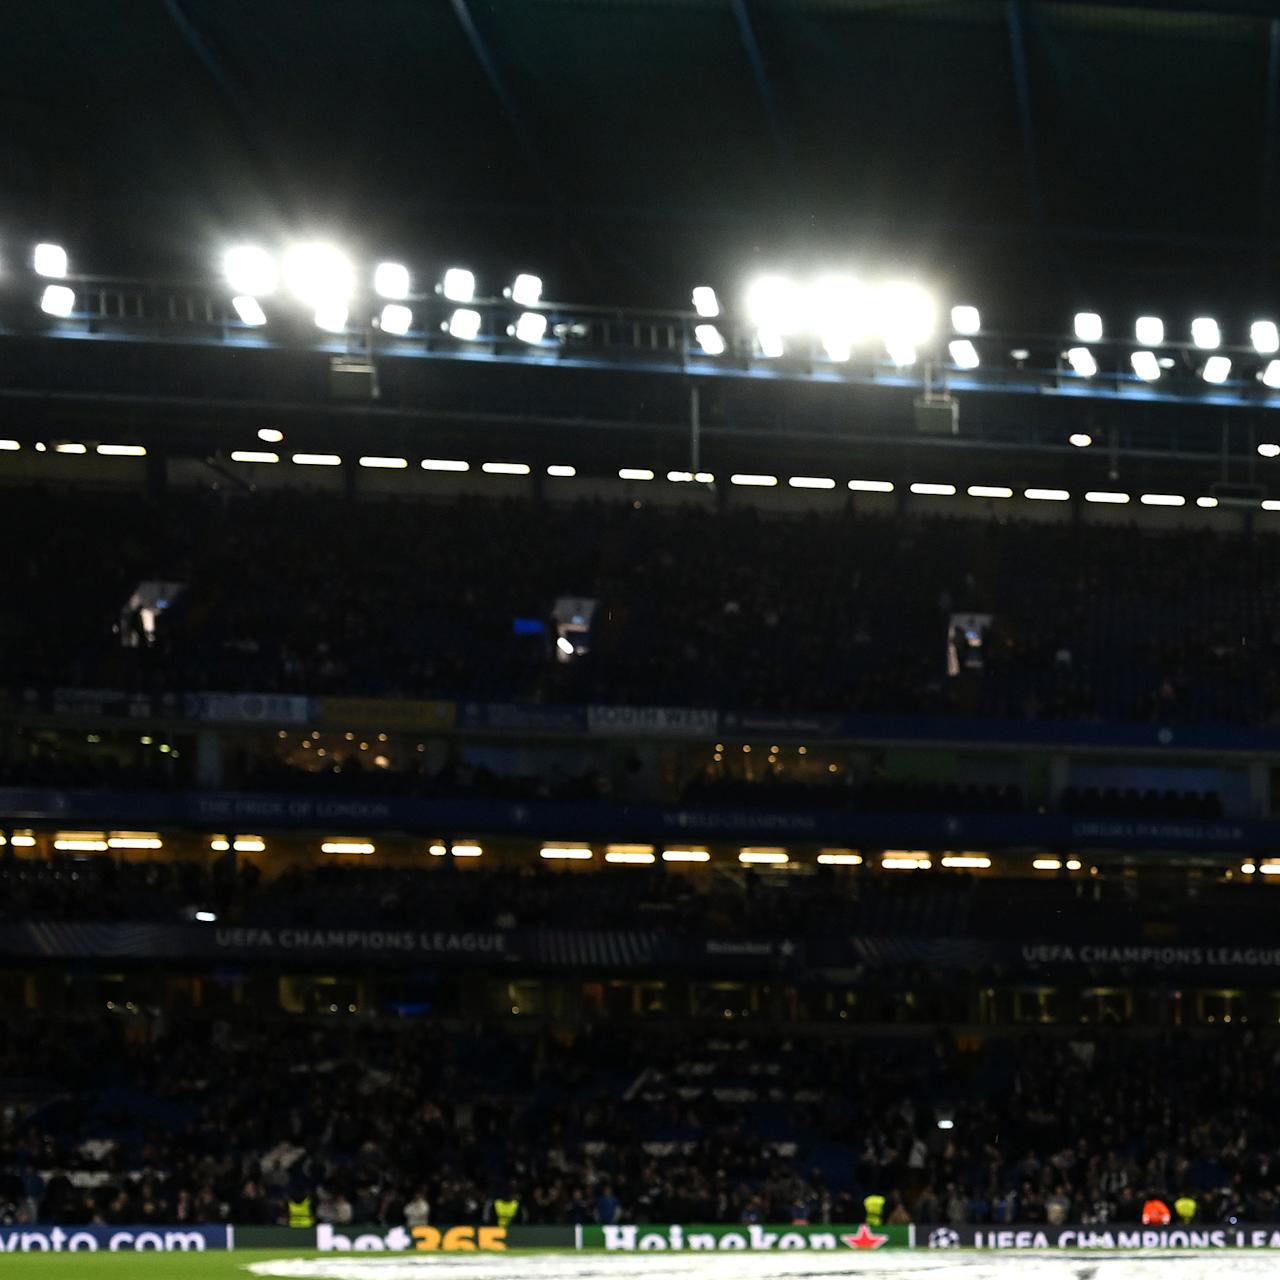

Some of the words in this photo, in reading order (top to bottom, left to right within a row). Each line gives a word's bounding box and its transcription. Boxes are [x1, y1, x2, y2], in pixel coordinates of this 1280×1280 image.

[216, 927, 274, 946] UEFA
[278, 928, 416, 950] CHAMPIONS
[420, 931, 505, 951] LEAGUE
[1021, 944, 1075, 962] UEFA
[1078, 945, 1204, 965] CHAMPIONS
[316, 1223, 508, 1250] bet365
[603, 1225, 838, 1250] Heineken
[974, 1231, 1050, 1249] UEFA
[1058, 1231, 1226, 1249] CHAMPIONS
